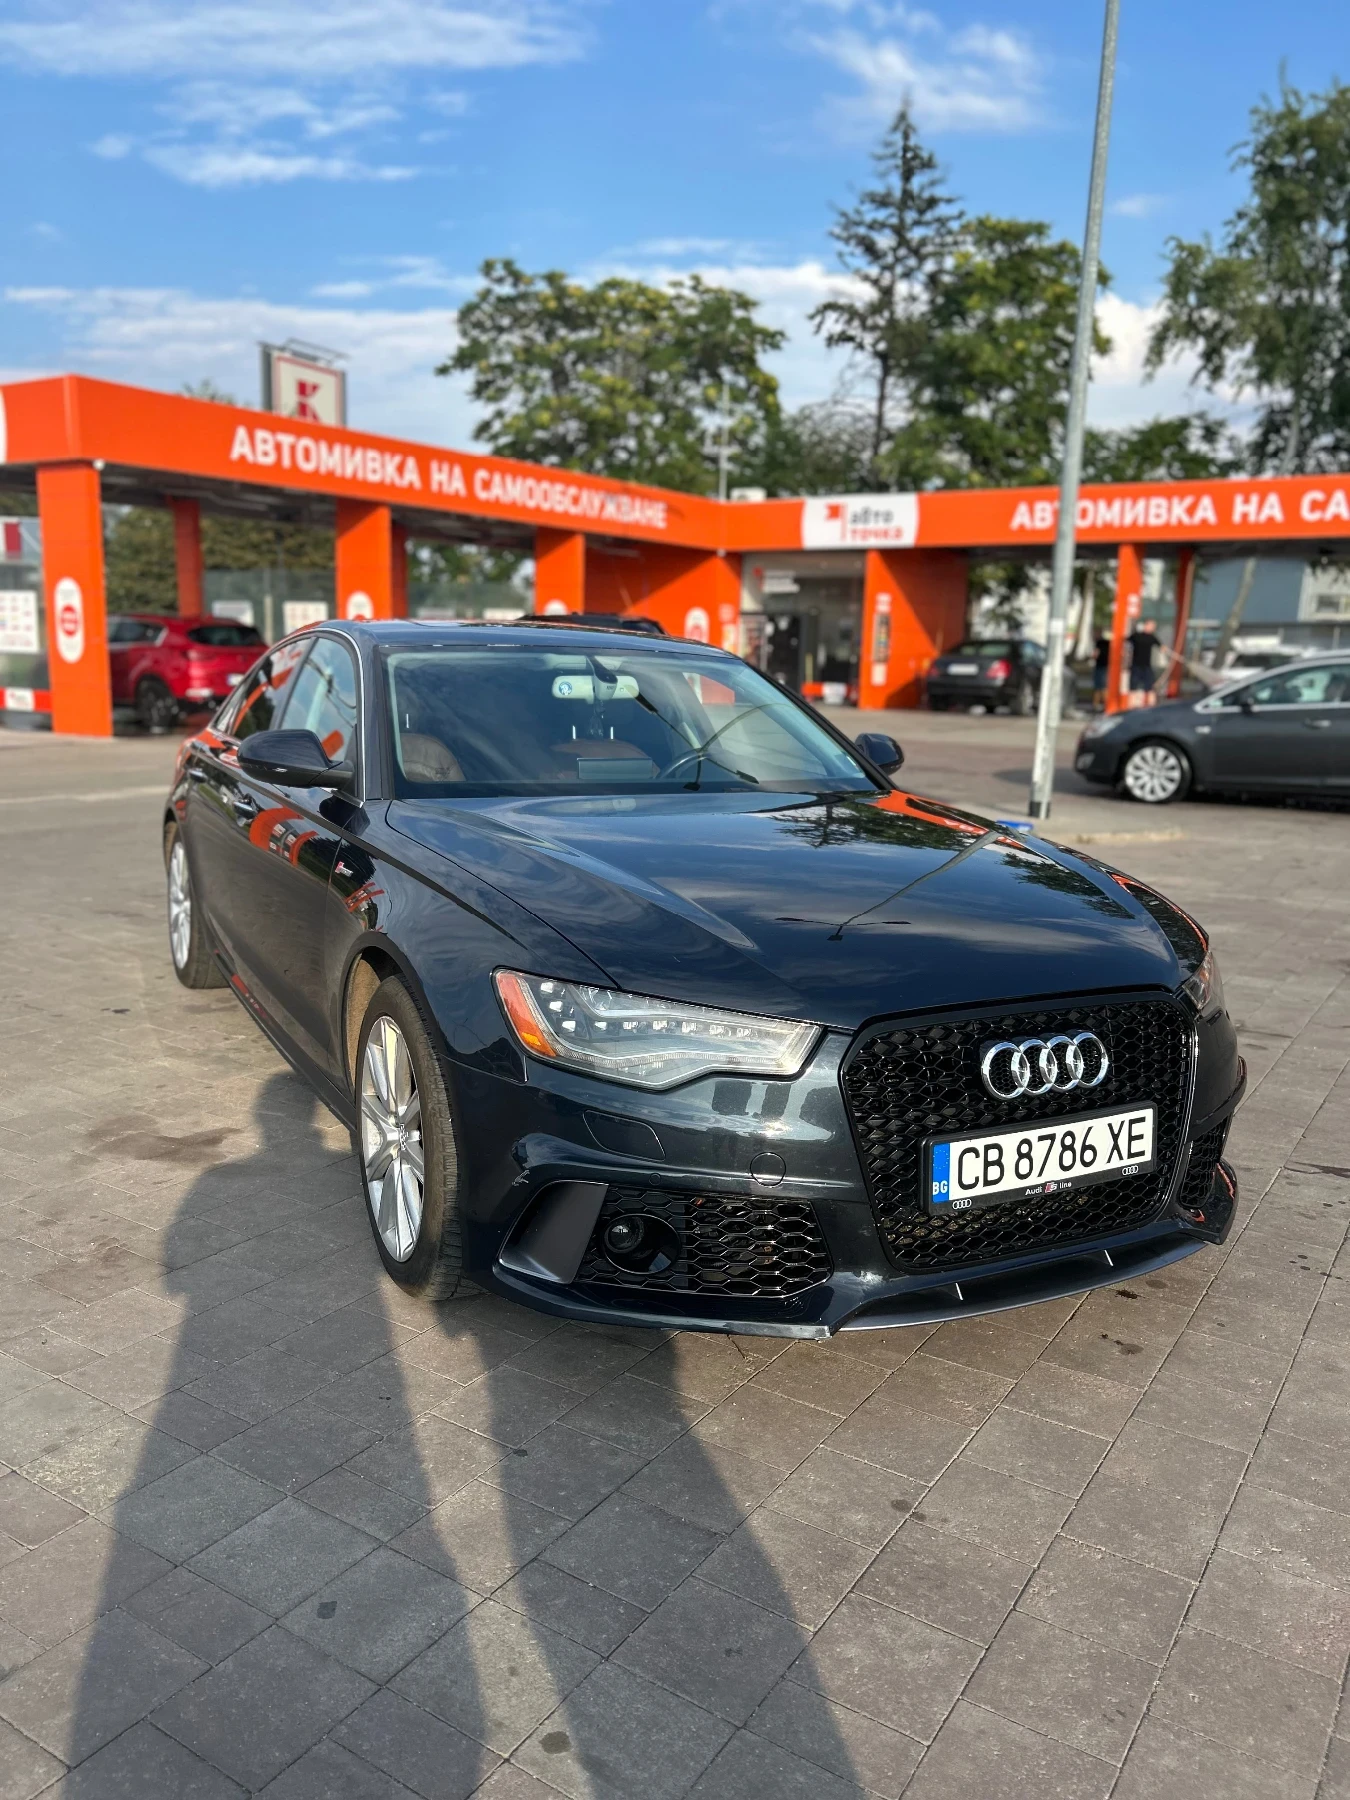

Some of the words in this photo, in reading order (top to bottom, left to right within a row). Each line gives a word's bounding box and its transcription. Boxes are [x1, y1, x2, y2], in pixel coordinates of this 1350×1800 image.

[229, 424, 422, 490] АВТОМИВКА
[430, 459, 467, 498] НА
[473, 467, 668, 530] САМООБСЛУЖВАНЕ
[1009, 494, 1218, 531] АВОМИВКА
[1231, 485, 1285, 525] НА
[1300, 487, 1350, 522] СА
[957, 1142, 1005, 1191] CB
[1014, 1125, 1098, 1180] 8786
[1105, 1116, 1147, 1164] XE
[932, 1180, 948, 1196] BG
[1025, 1186, 1043, 1196] Audi
[1059, 1181, 1072, 1189] line
